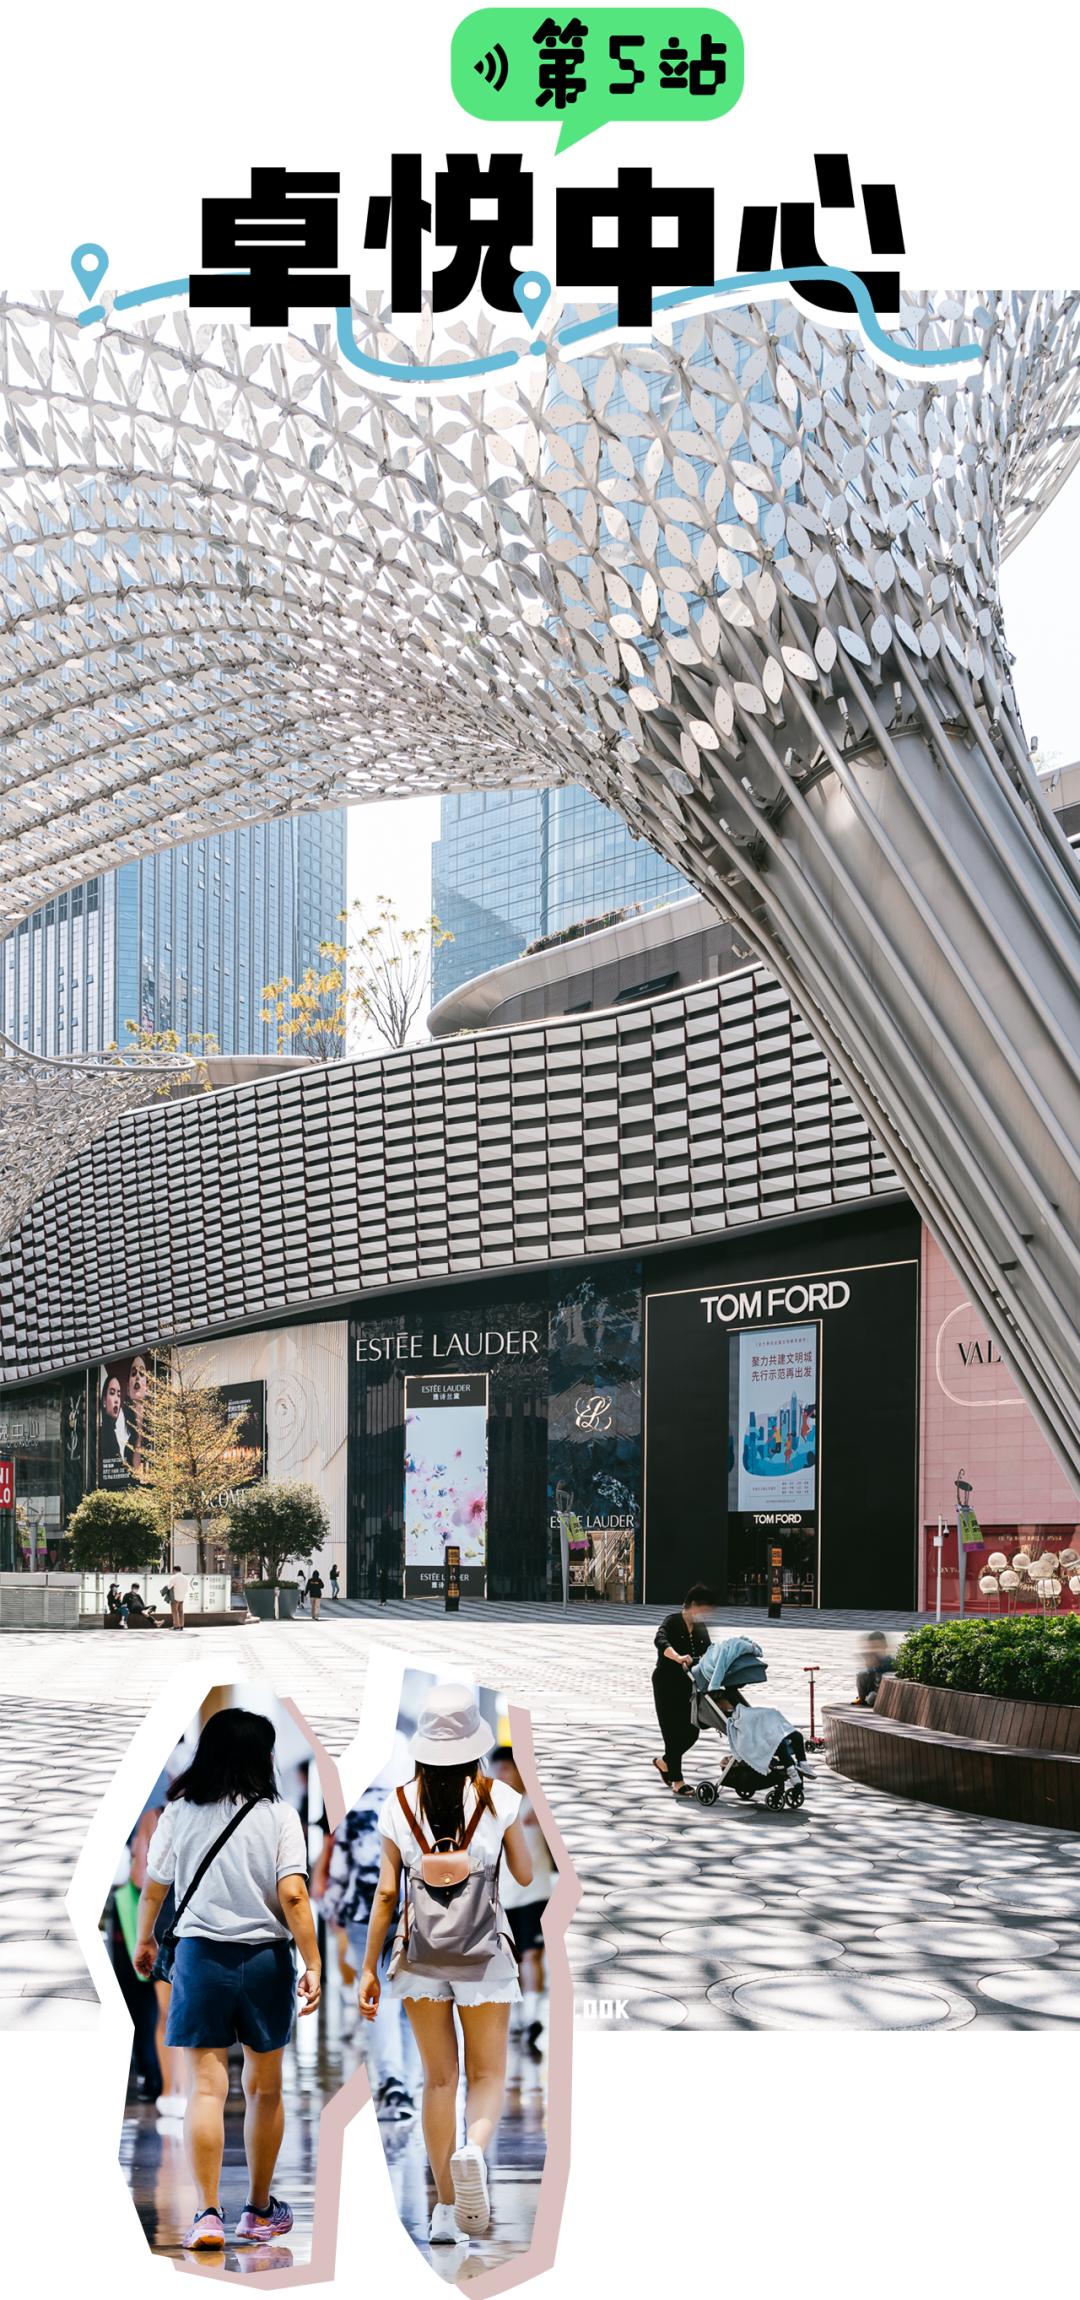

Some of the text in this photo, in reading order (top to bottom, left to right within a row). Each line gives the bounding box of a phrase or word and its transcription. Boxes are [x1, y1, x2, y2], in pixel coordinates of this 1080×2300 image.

[700, 1281, 850, 1323] TOM FORD
[433, 1330, 539, 1357] LAUDER
[751, 1366, 813, 1382] 先行示范再出发
[443, 1384, 471, 1392] LAUDER
[586, 1515, 634, 1528] LAUDER
[753, 1514, 802, 1524] TOM FORD
